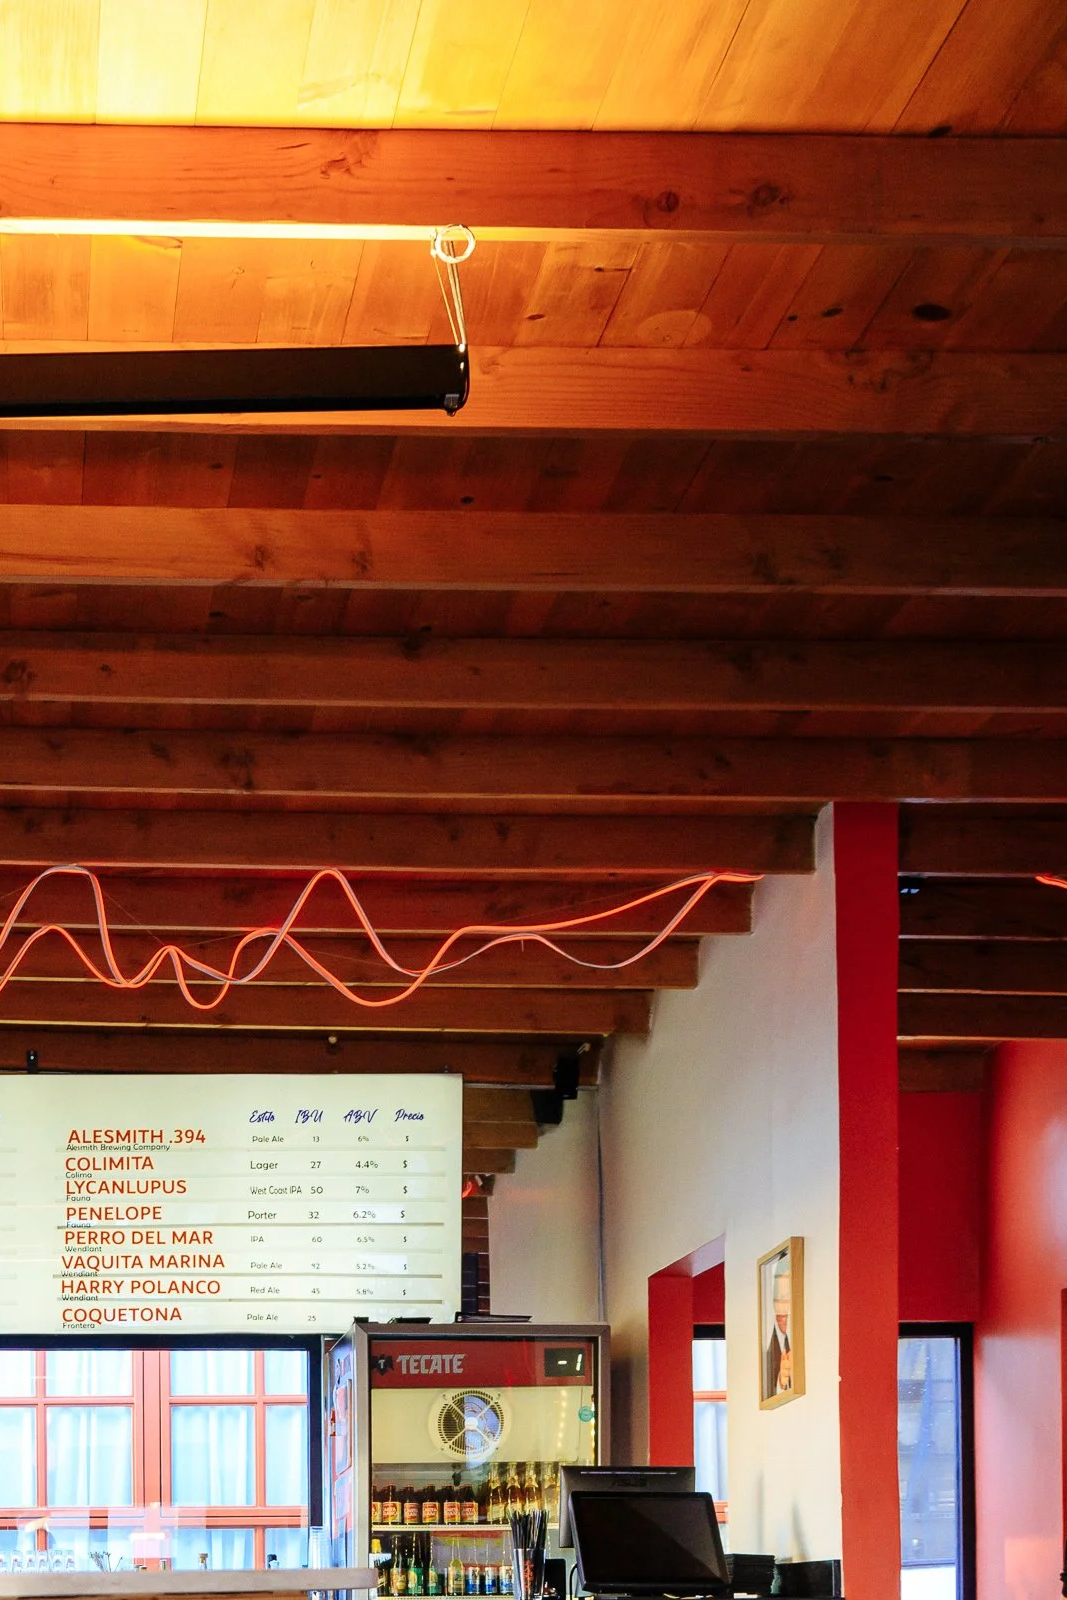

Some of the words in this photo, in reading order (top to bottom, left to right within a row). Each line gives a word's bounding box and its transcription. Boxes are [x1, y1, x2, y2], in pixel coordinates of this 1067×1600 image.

[249, 1110, 275, 1123] Estilo
[295, 1110, 324, 1123] IBU
[343, 1109, 378, 1123] ABV
[395, 1109, 424, 1121] Precio
[68, 1130, 163, 1143] ALESMITH
[169, 1130, 206, 1143] .394
[101, 1144, 131, 1152] Brewing
[65, 1156, 154, 1171] COLIMITA
[250, 1161, 278, 1170] Lager
[403, 1160, 407, 1168] $
[66, 1180, 187, 1195] LYCANLUPUS
[250, 1186, 267, 1195] West
[269, 1186, 288, 1195] Coast
[290, 1186, 302, 1194] IPA
[311, 1186, 323, 1194] 50
[403, 1186, 408, 1194] $
[67, 1206, 162, 1221] PENELOPE
[248, 1211, 277, 1220] Porter
[65, 1231, 125, 1245] PERRO
[132, 1231, 166, 1245] DEL
[172, 1231, 213, 1244] MAR
[62, 1255, 143, 1272] VAQUITA
[150, 1254, 225, 1268] MARINA
[62, 1280, 124, 1294] HARRY
[131, 1280, 221, 1294] POLANCO
[62, 1308, 182, 1324] COQUETONA
[396, 1354, 467, 1374] TECATE
